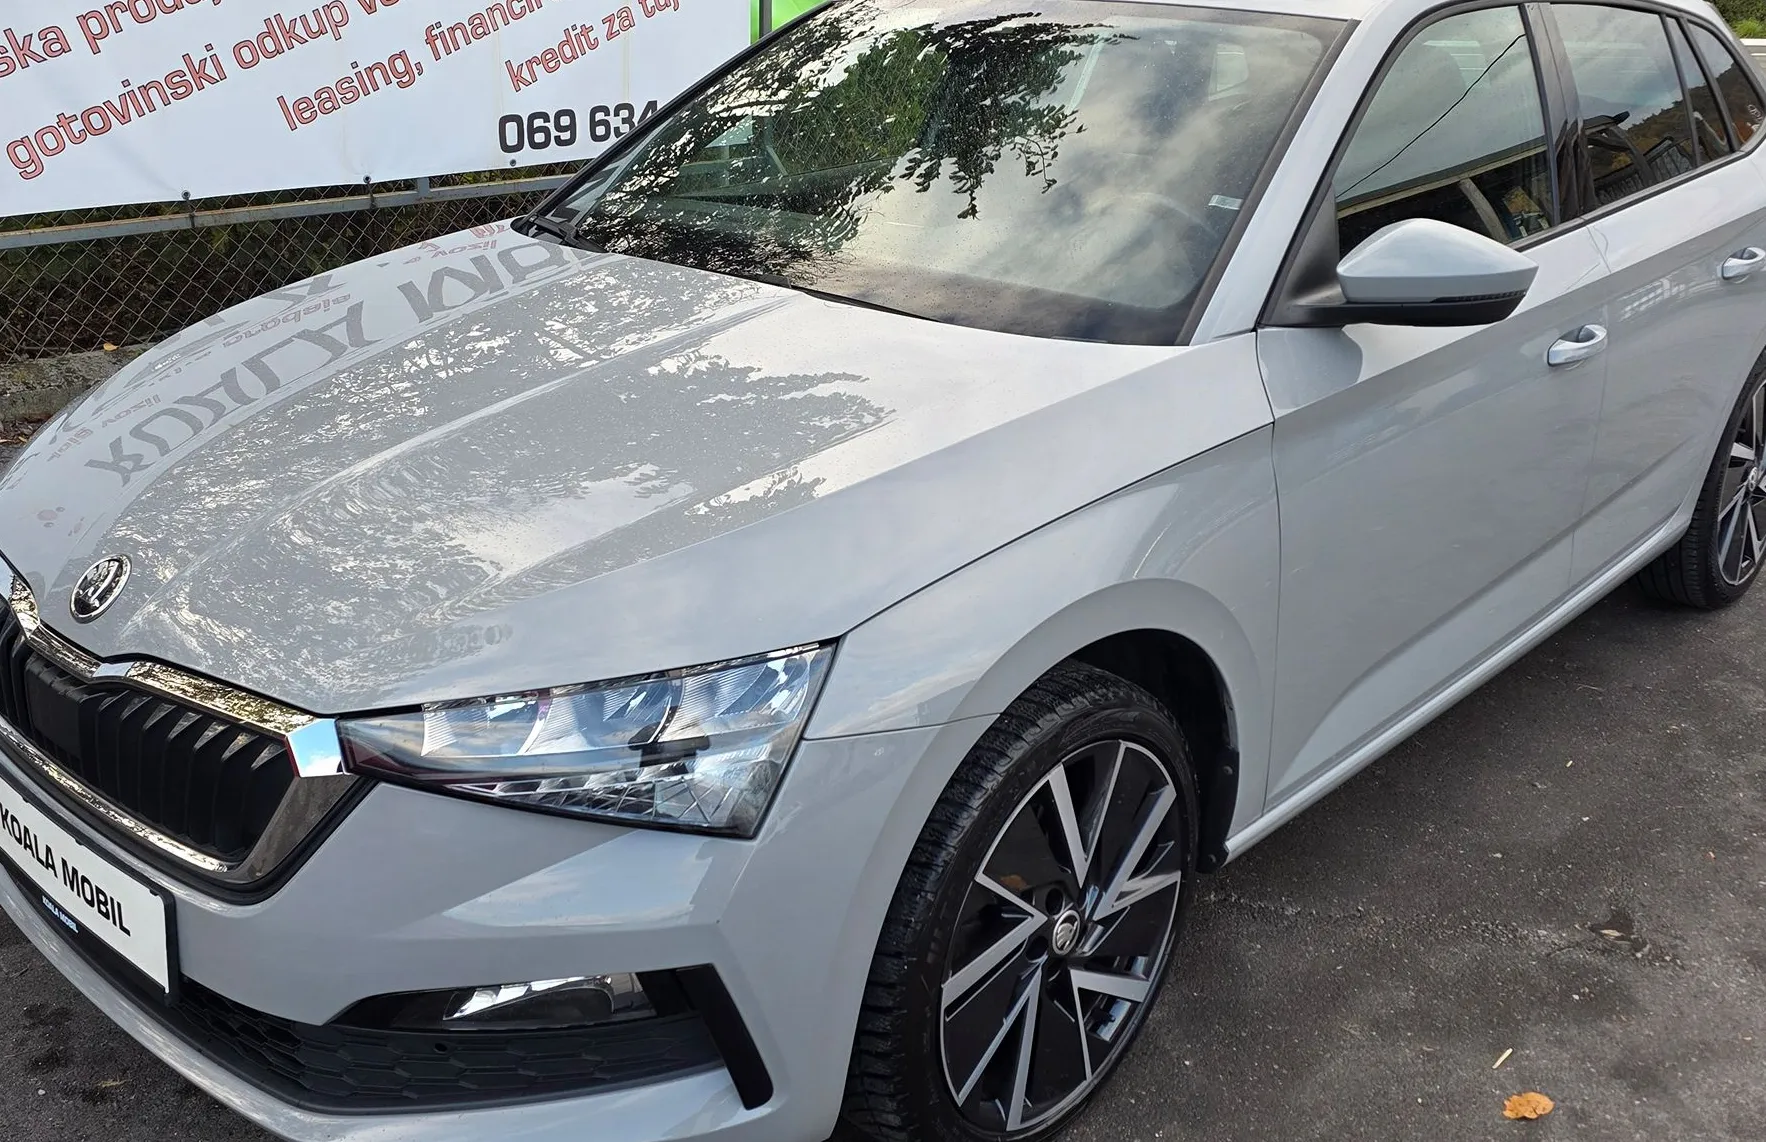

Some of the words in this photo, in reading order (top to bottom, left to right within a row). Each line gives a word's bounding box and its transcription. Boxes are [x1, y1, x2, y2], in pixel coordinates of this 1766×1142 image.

[76, 0, 221, 55] pro
[505, 24, 599, 92] kredit
[602, 6, 635, 41] za
[6, 43, 227, 180] gotovinski
[233, 0, 349, 69] odkup
[277, 50, 423, 131] leasing,
[499, 109, 576, 153] 069
[0, 802, 58, 879] KOALA
[61, 857, 131, 937] MOBIL
